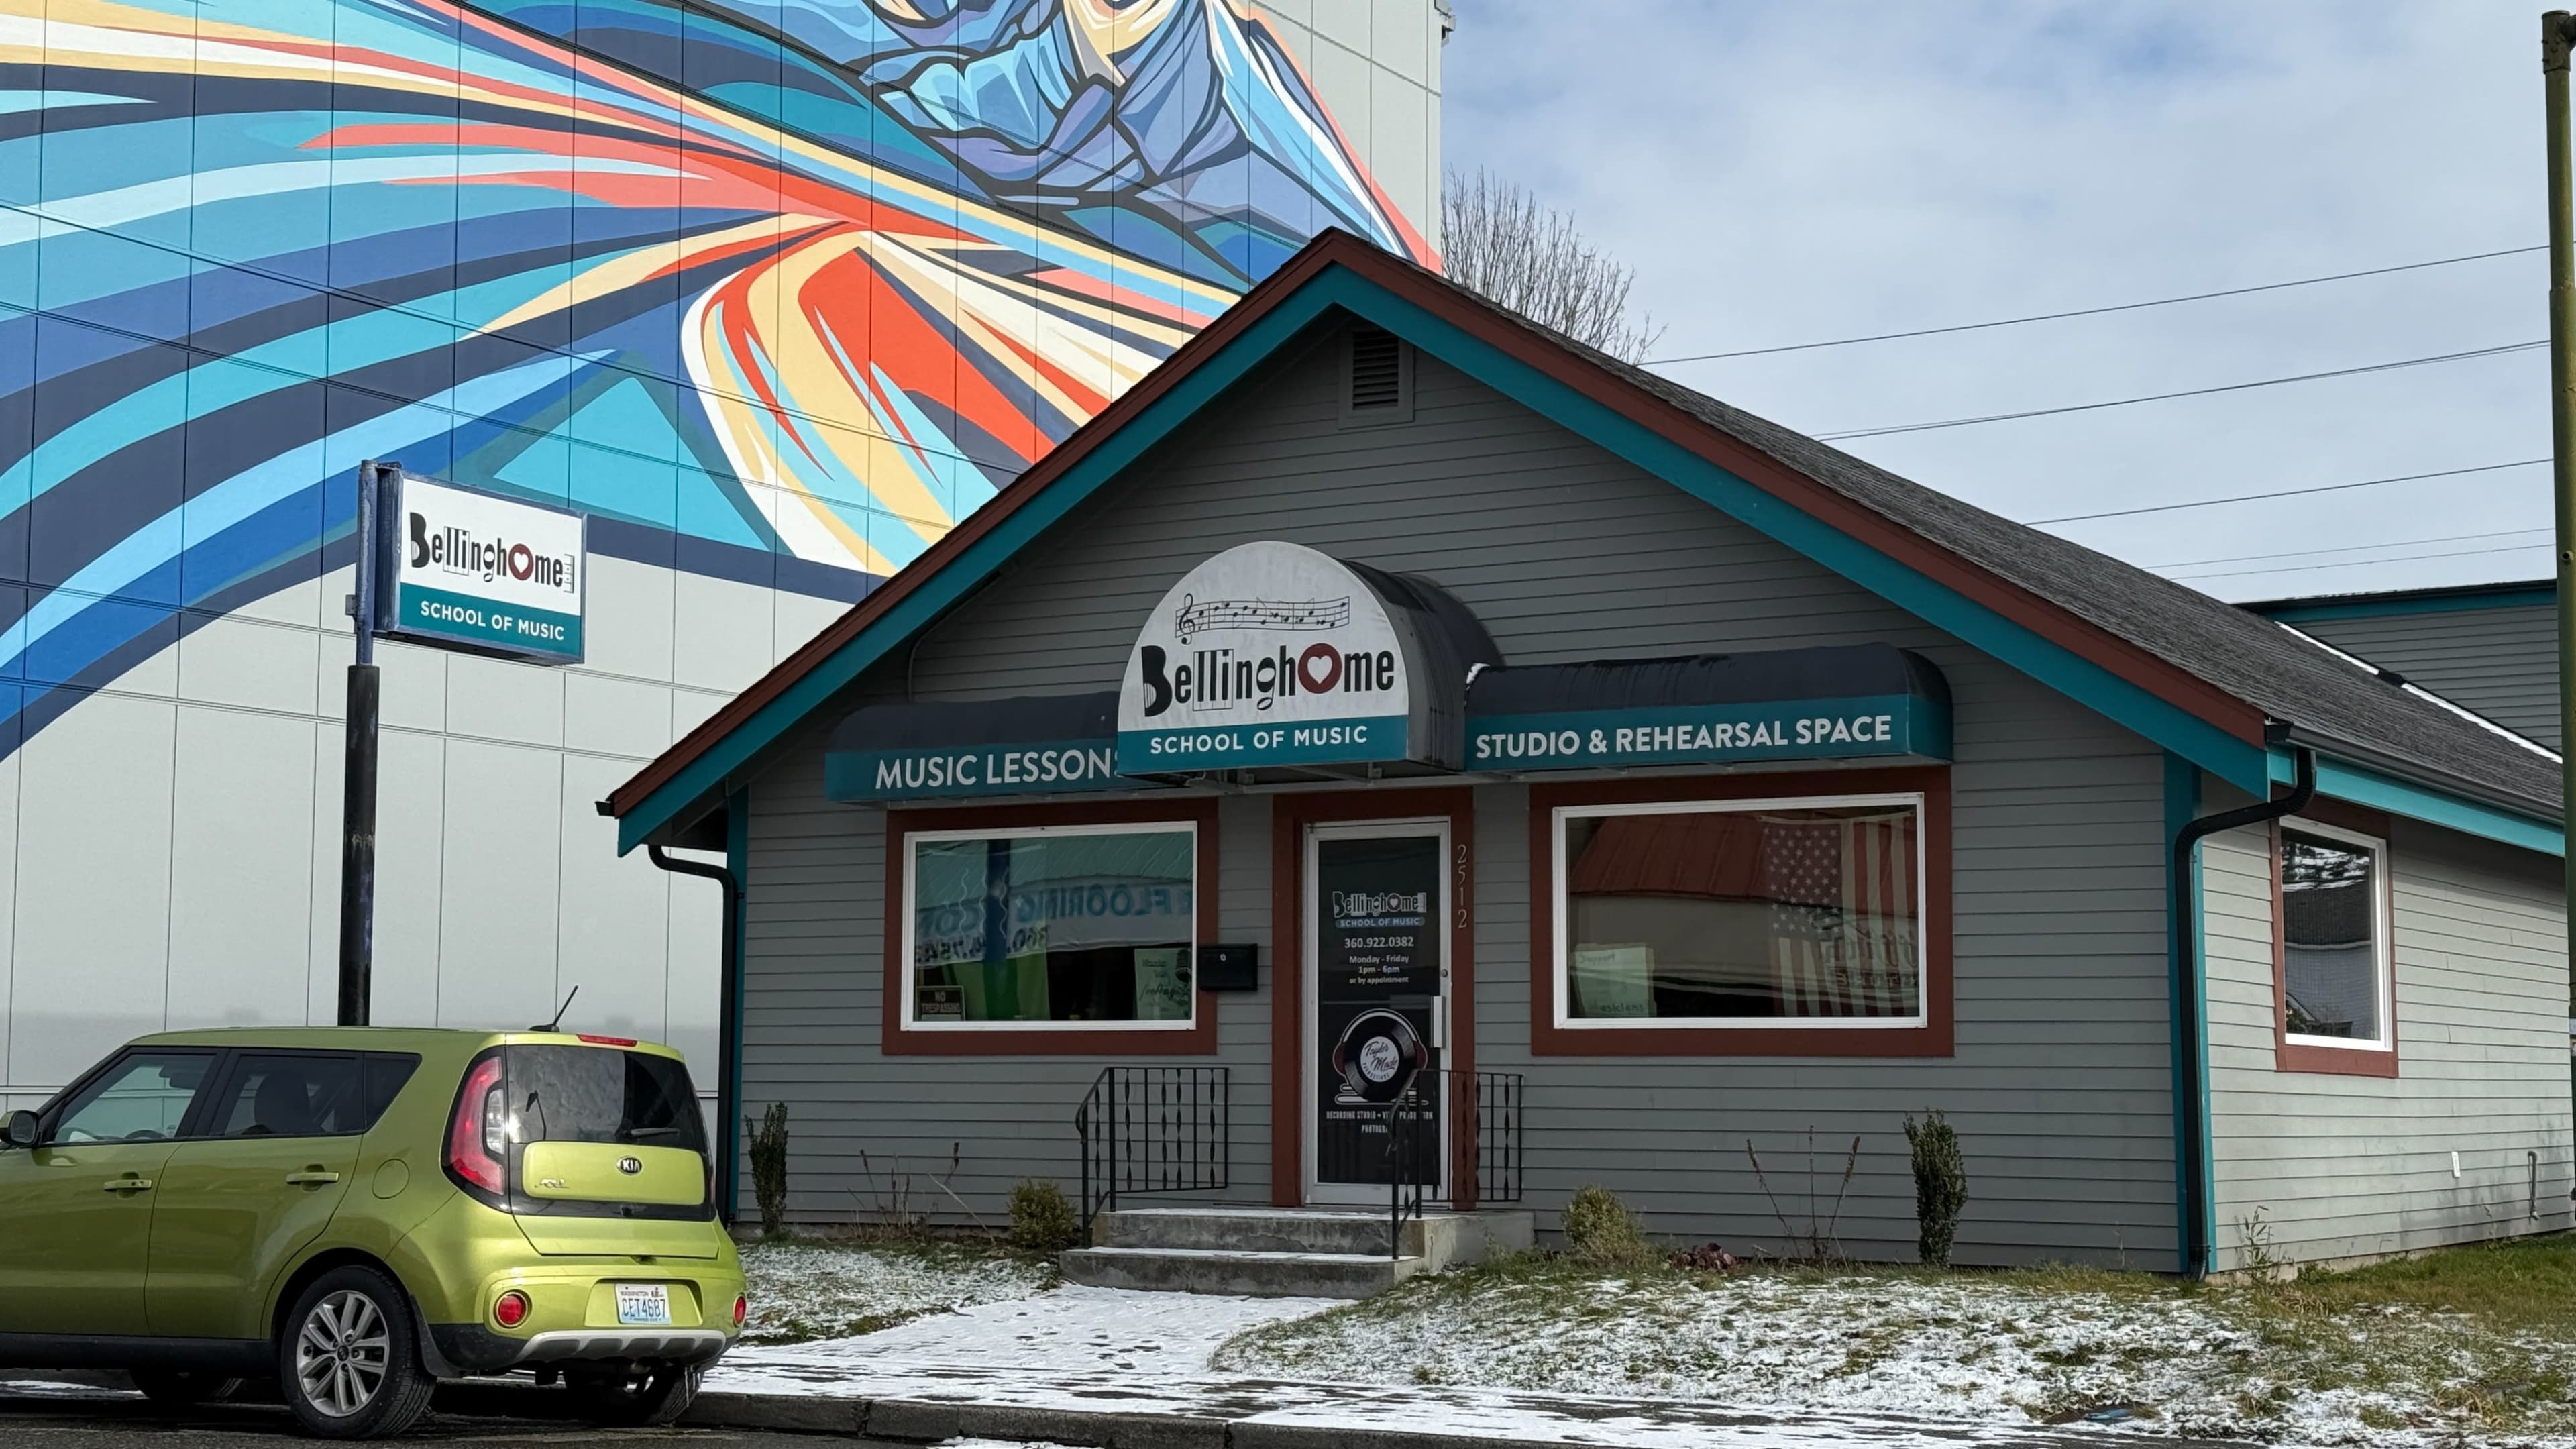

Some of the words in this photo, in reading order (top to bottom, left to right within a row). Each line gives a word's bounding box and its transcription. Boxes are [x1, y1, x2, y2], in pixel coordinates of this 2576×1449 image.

[409, 512, 564, 587] Bellinghome
[421, 601, 486, 627] SCHOOL
[492, 614, 513, 630] OF
[519, 620, 564, 641] MUSIC
[1141, 643, 1395, 717] Bellinghome
[1150, 733, 1244, 755] SCHOOL
[1254, 731, 1285, 749] OF
[1294, 725, 1368, 747] MUSIC
[1477, 731, 1580, 759] STUDIO
[1589, 729, 1607, 754] &
[1616, 720, 1788, 753] REHEARSAL
[1796, 715, 1892, 745] SPACE
[875, 755, 977, 790] MUSIC
[987, 747, 1118, 784] LESSON
[1458, 844, 1467, 928] 2512
[1340, 918, 1376, 926] SCHOOL
[1378, 918, 1391, 926] OF
[1393, 918, 1420, 926] MUSIC
[1344, 936, 1414, 949] 360.922.0382
[1349, 955, 1380, 964] Monday
[1386, 955, 1409, 964] Friday
[1358, 966, 1376, 975] 1pm
[1383, 965, 1400, 974] 6pm
[1358, 977, 1366, 985] by
[1367, 977, 1409, 985] appointment
[934, 991, 946, 1002] NO
[1326, 1110, 1356, 1120] RECORDING
[1356, 1110, 1376, 1120] STUDIO
[623, 1159, 640, 1172] KIA
[622, 1297, 665, 1318] CET4687
